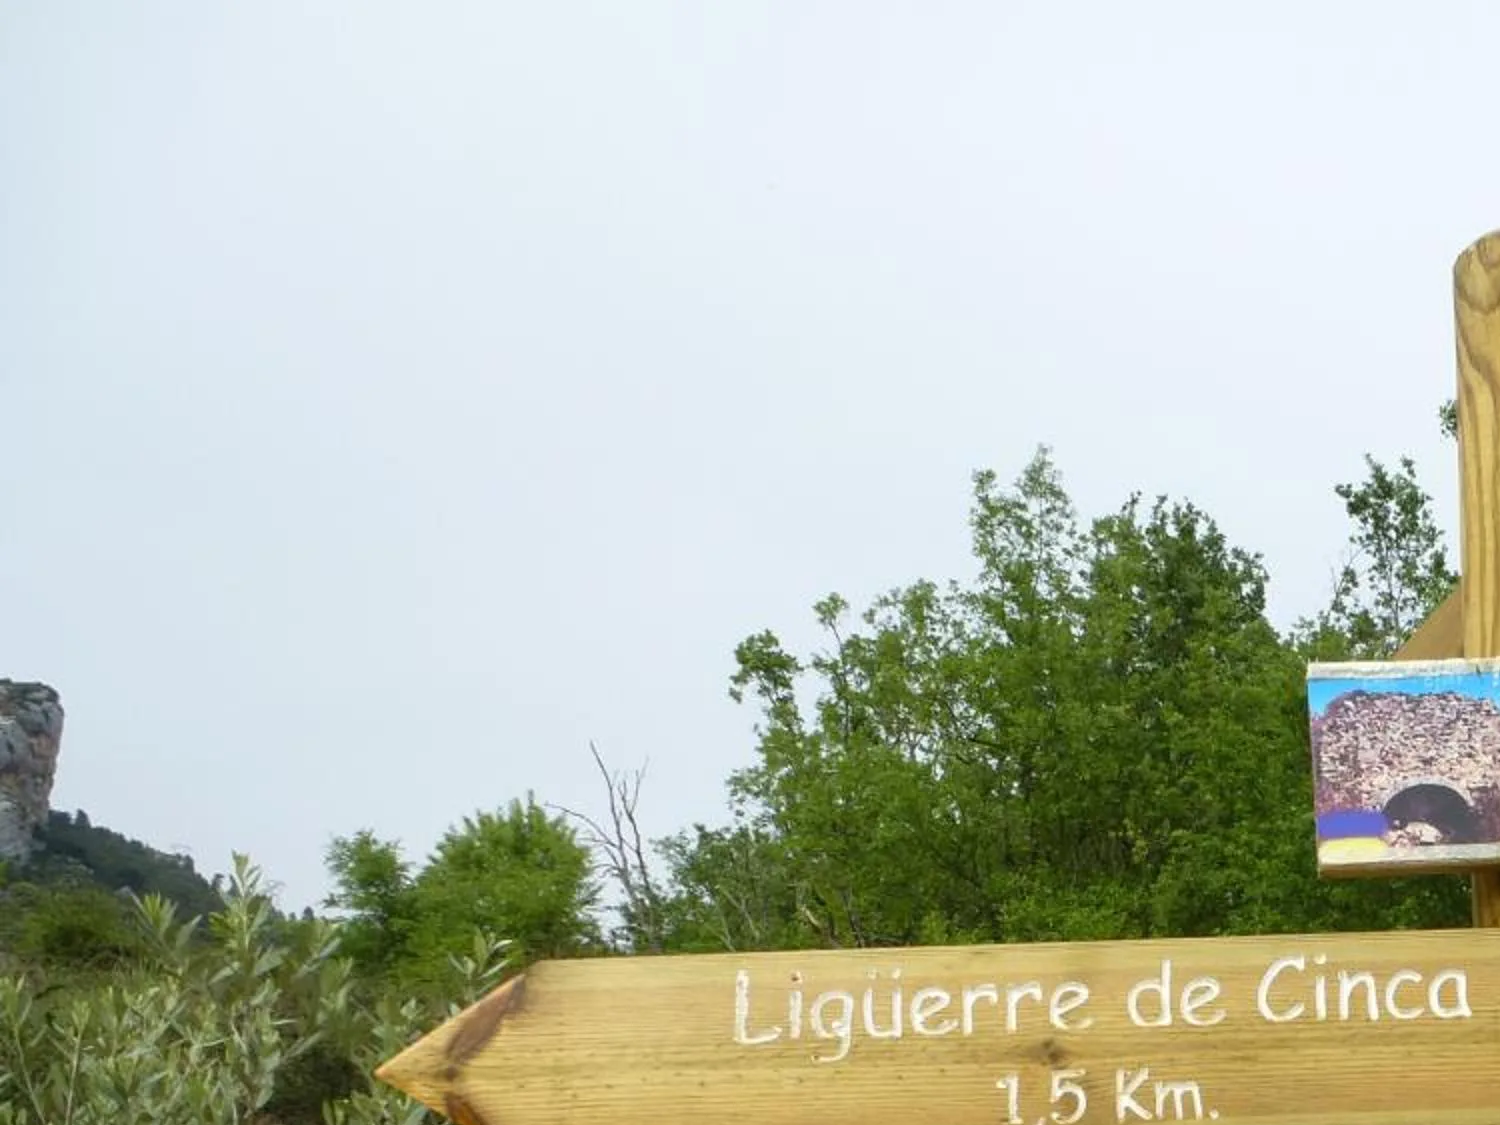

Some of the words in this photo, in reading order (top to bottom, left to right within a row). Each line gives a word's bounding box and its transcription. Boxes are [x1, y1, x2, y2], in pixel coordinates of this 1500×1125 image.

[732, 965, 1092, 1062] Ligüerre
[1125, 957, 1227, 1027] de
[1255, 952, 1475, 1024] Cinca
[1115, 1067, 1220, 1123] Km.
